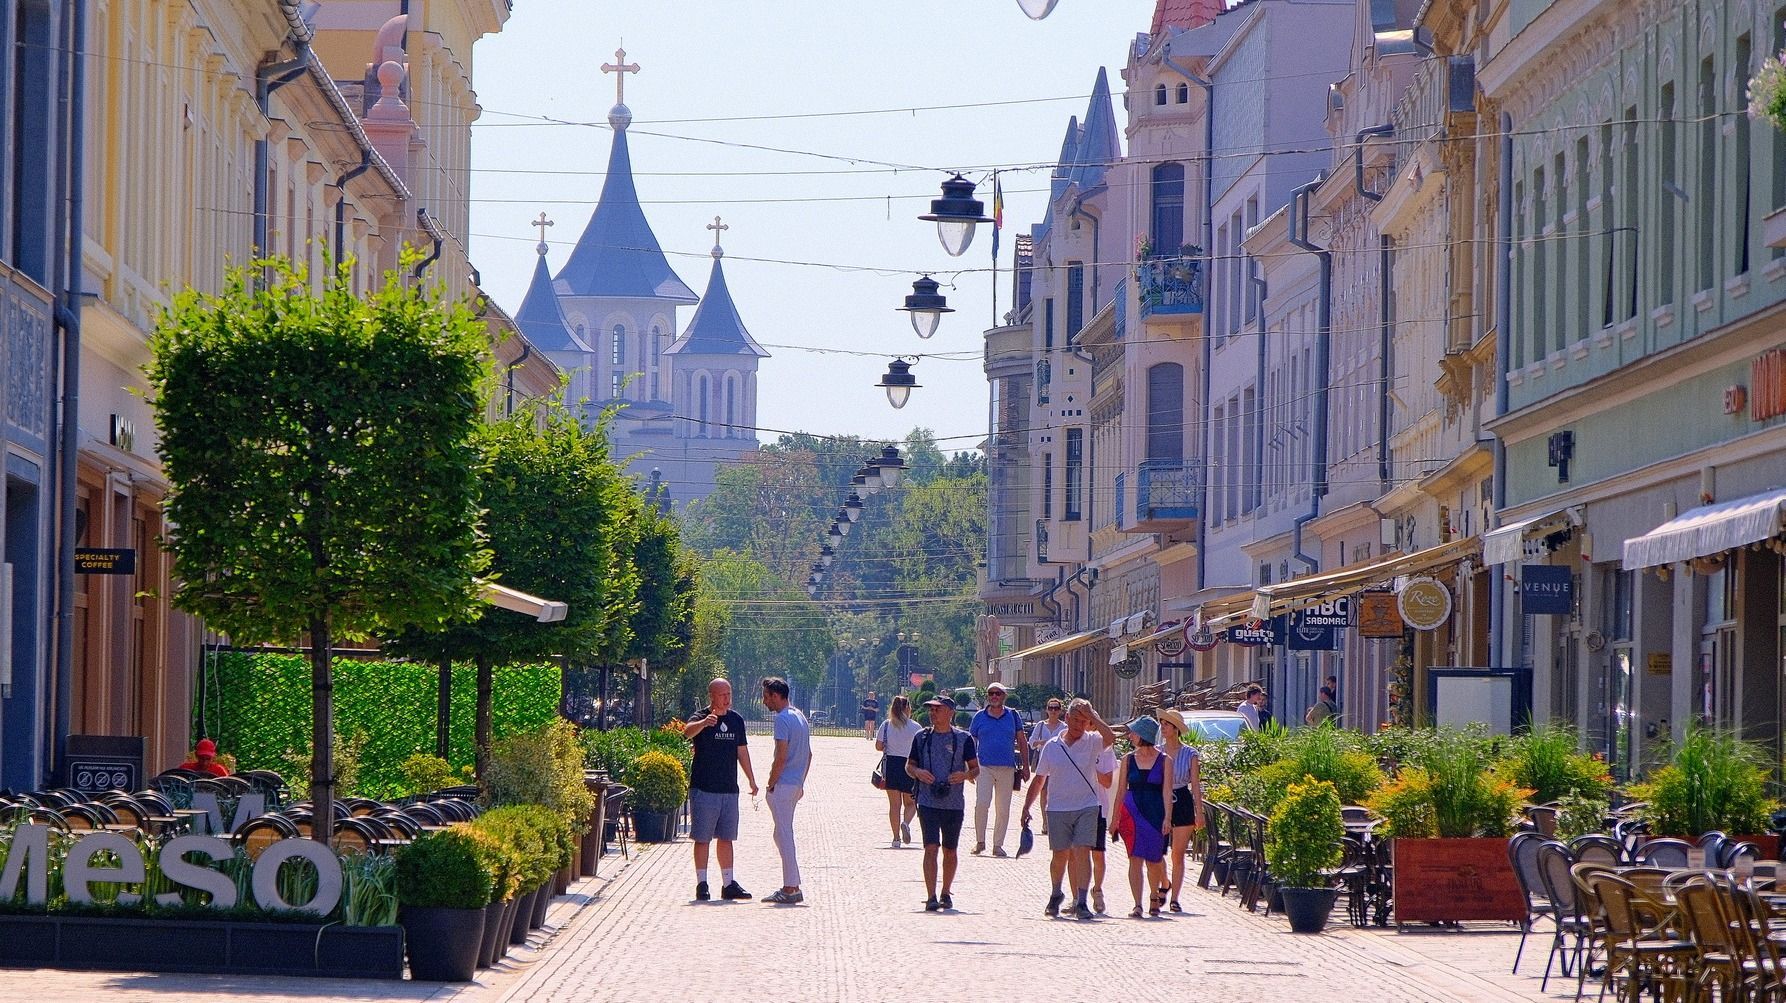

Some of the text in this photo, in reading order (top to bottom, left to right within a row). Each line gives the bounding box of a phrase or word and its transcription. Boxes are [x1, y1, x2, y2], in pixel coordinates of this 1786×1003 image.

[81, 561, 113, 569] COFFEE
[1523, 582, 1569, 592] VENUE
[1307, 598, 1347, 615] ABC
[1306, 617, 1347, 625] SABOMAG
[0, 824, 343, 918] Meso
